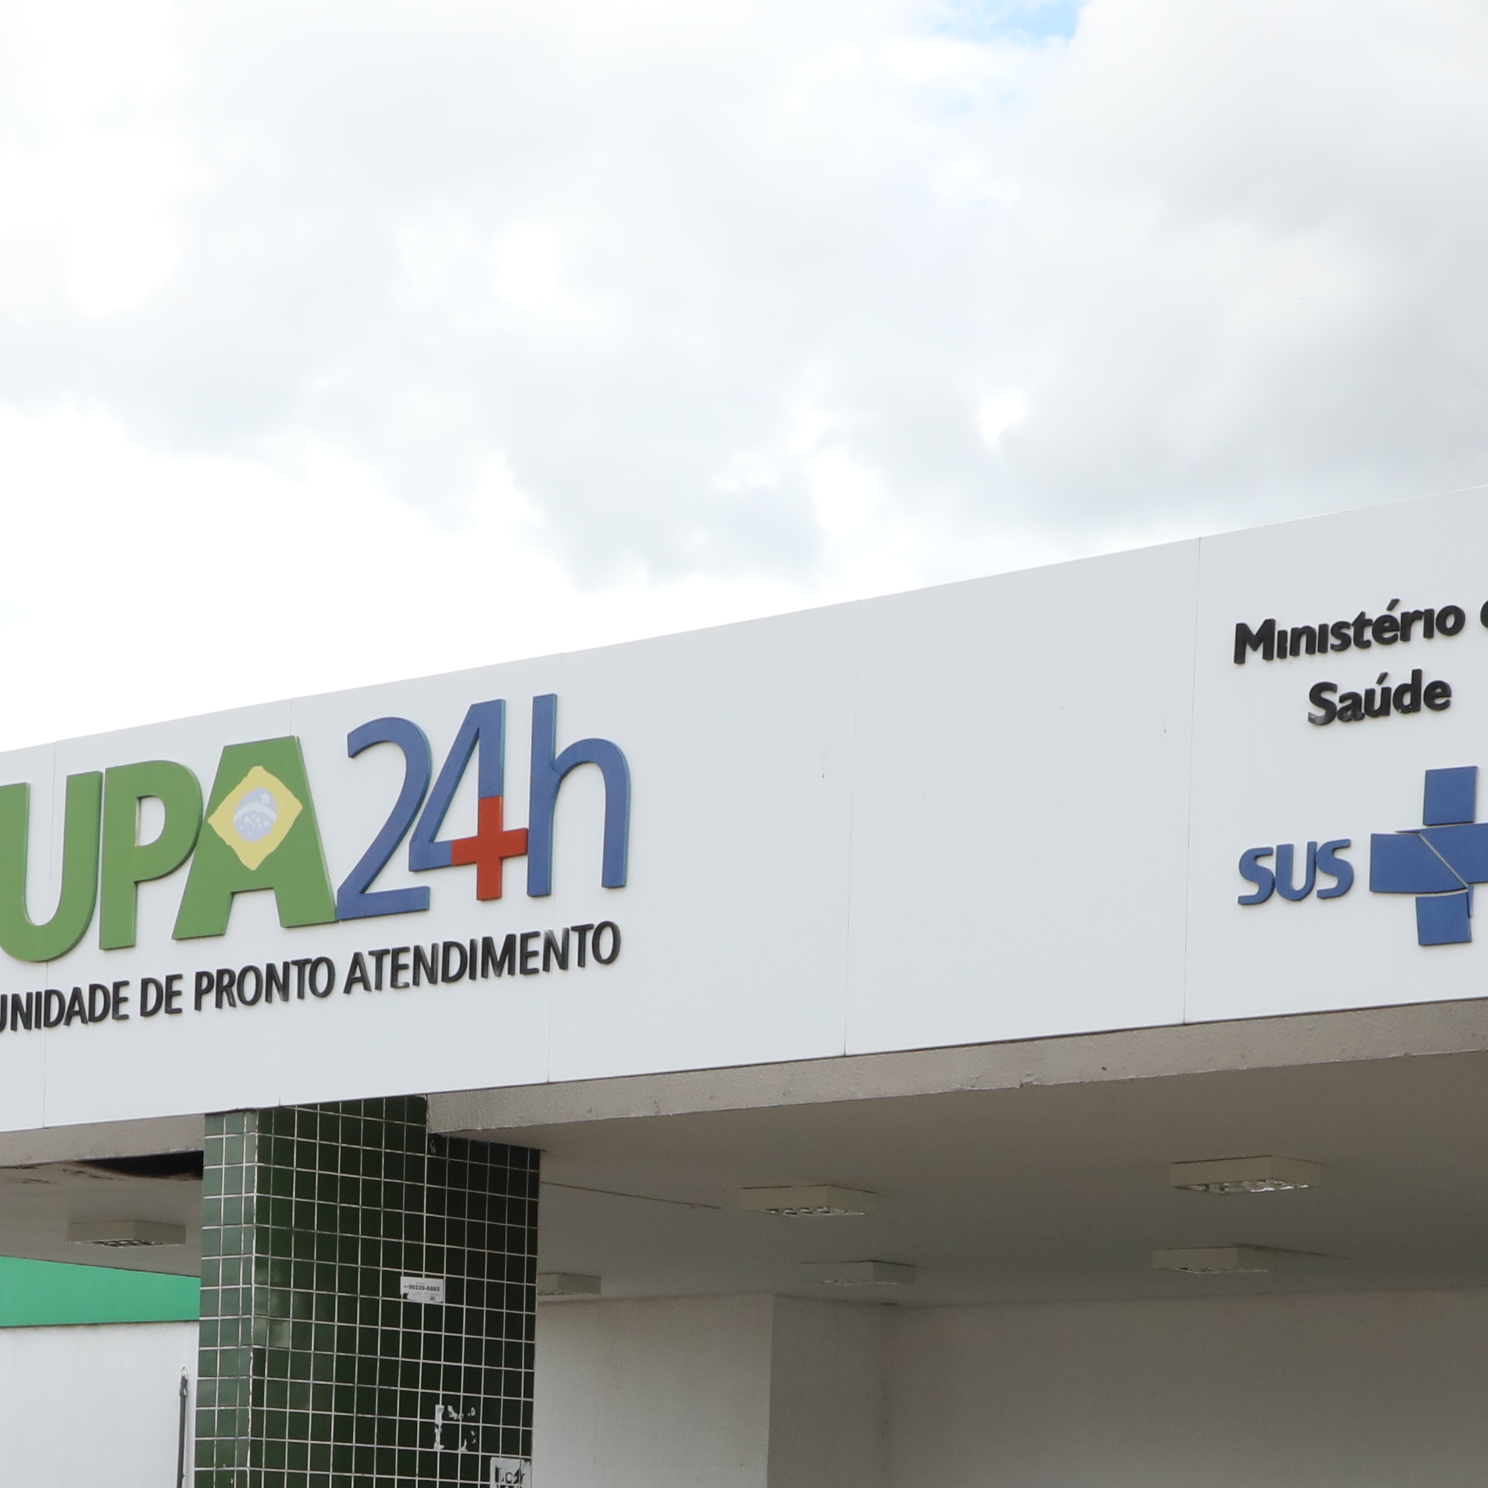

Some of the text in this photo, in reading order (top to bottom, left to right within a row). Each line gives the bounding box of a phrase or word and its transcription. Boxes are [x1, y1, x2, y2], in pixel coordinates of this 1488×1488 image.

[1233, 598, 1466, 665] Ministério
[1307, 668, 1453, 726] Saúde
[1237, 838, 1355, 906] SUS
[139, 972, 183, 1019] DE
[194, 956, 336, 1012] PRONTO
[343, 921, 622, 995] ATENDIMENTO
